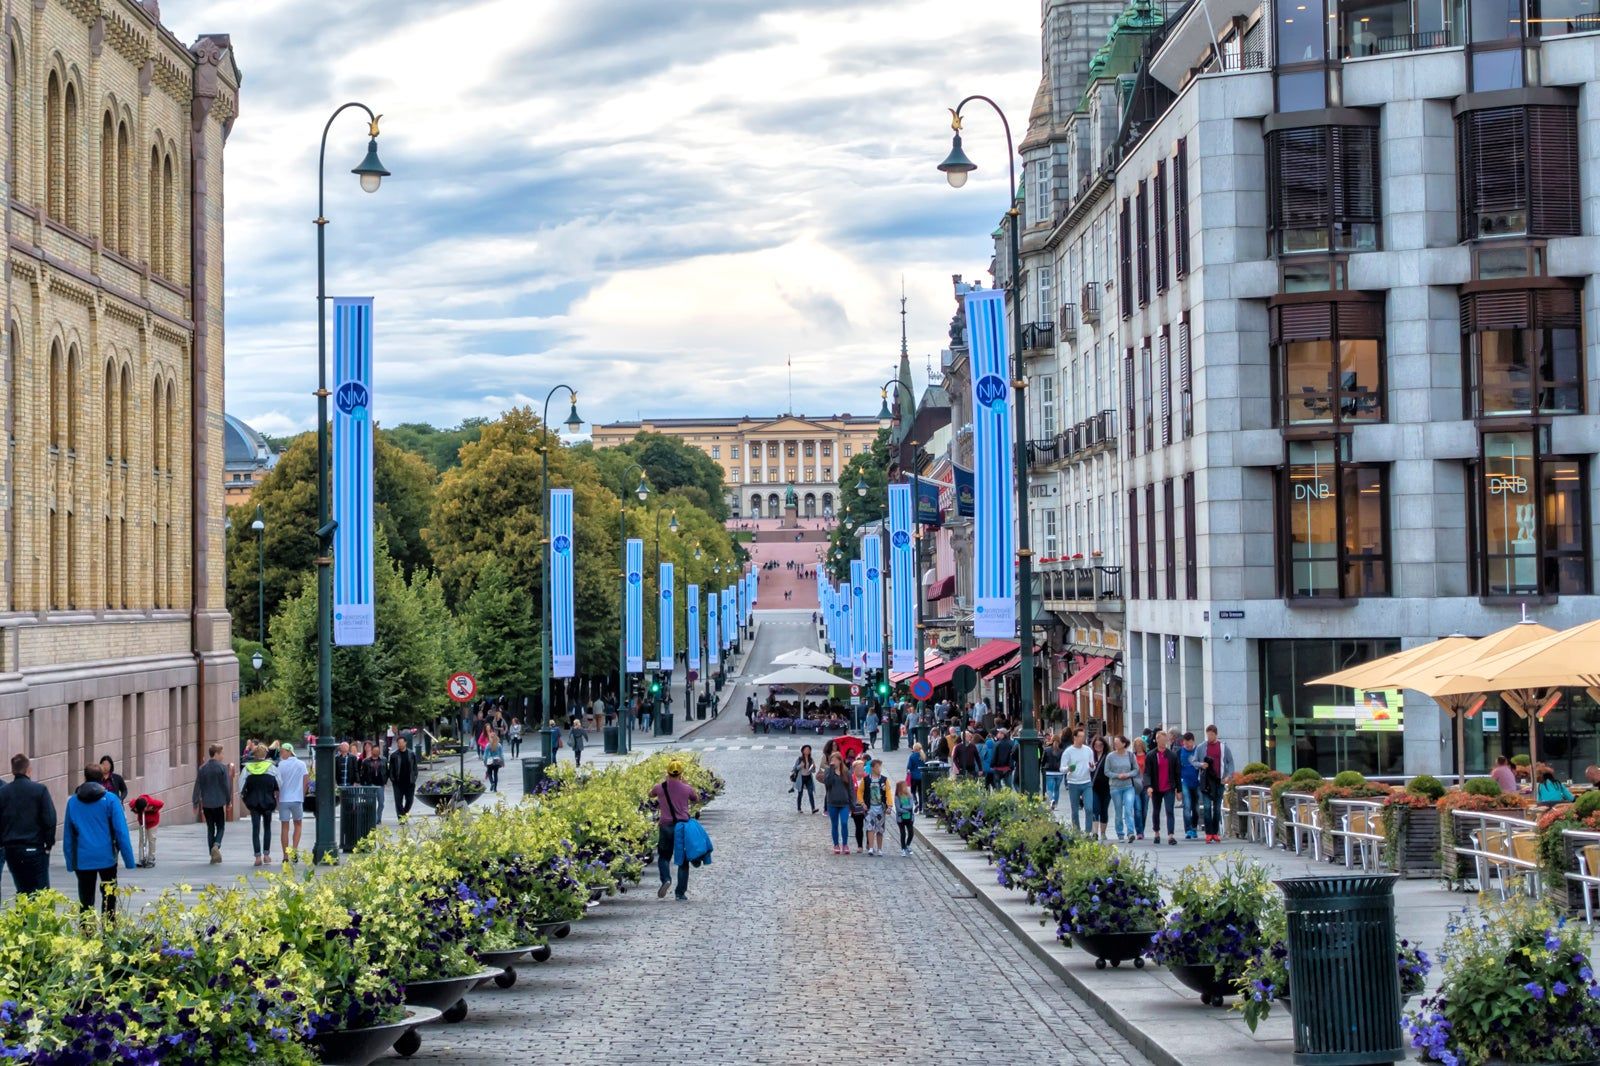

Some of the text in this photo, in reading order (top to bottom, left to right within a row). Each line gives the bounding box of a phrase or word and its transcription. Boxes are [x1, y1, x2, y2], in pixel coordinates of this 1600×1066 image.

[339, 382, 366, 410] NJM
[979, 376, 1004, 403] NJM
[1295, 483, 1330, 499] DNB
[1491, 478, 1528, 494] DNB
